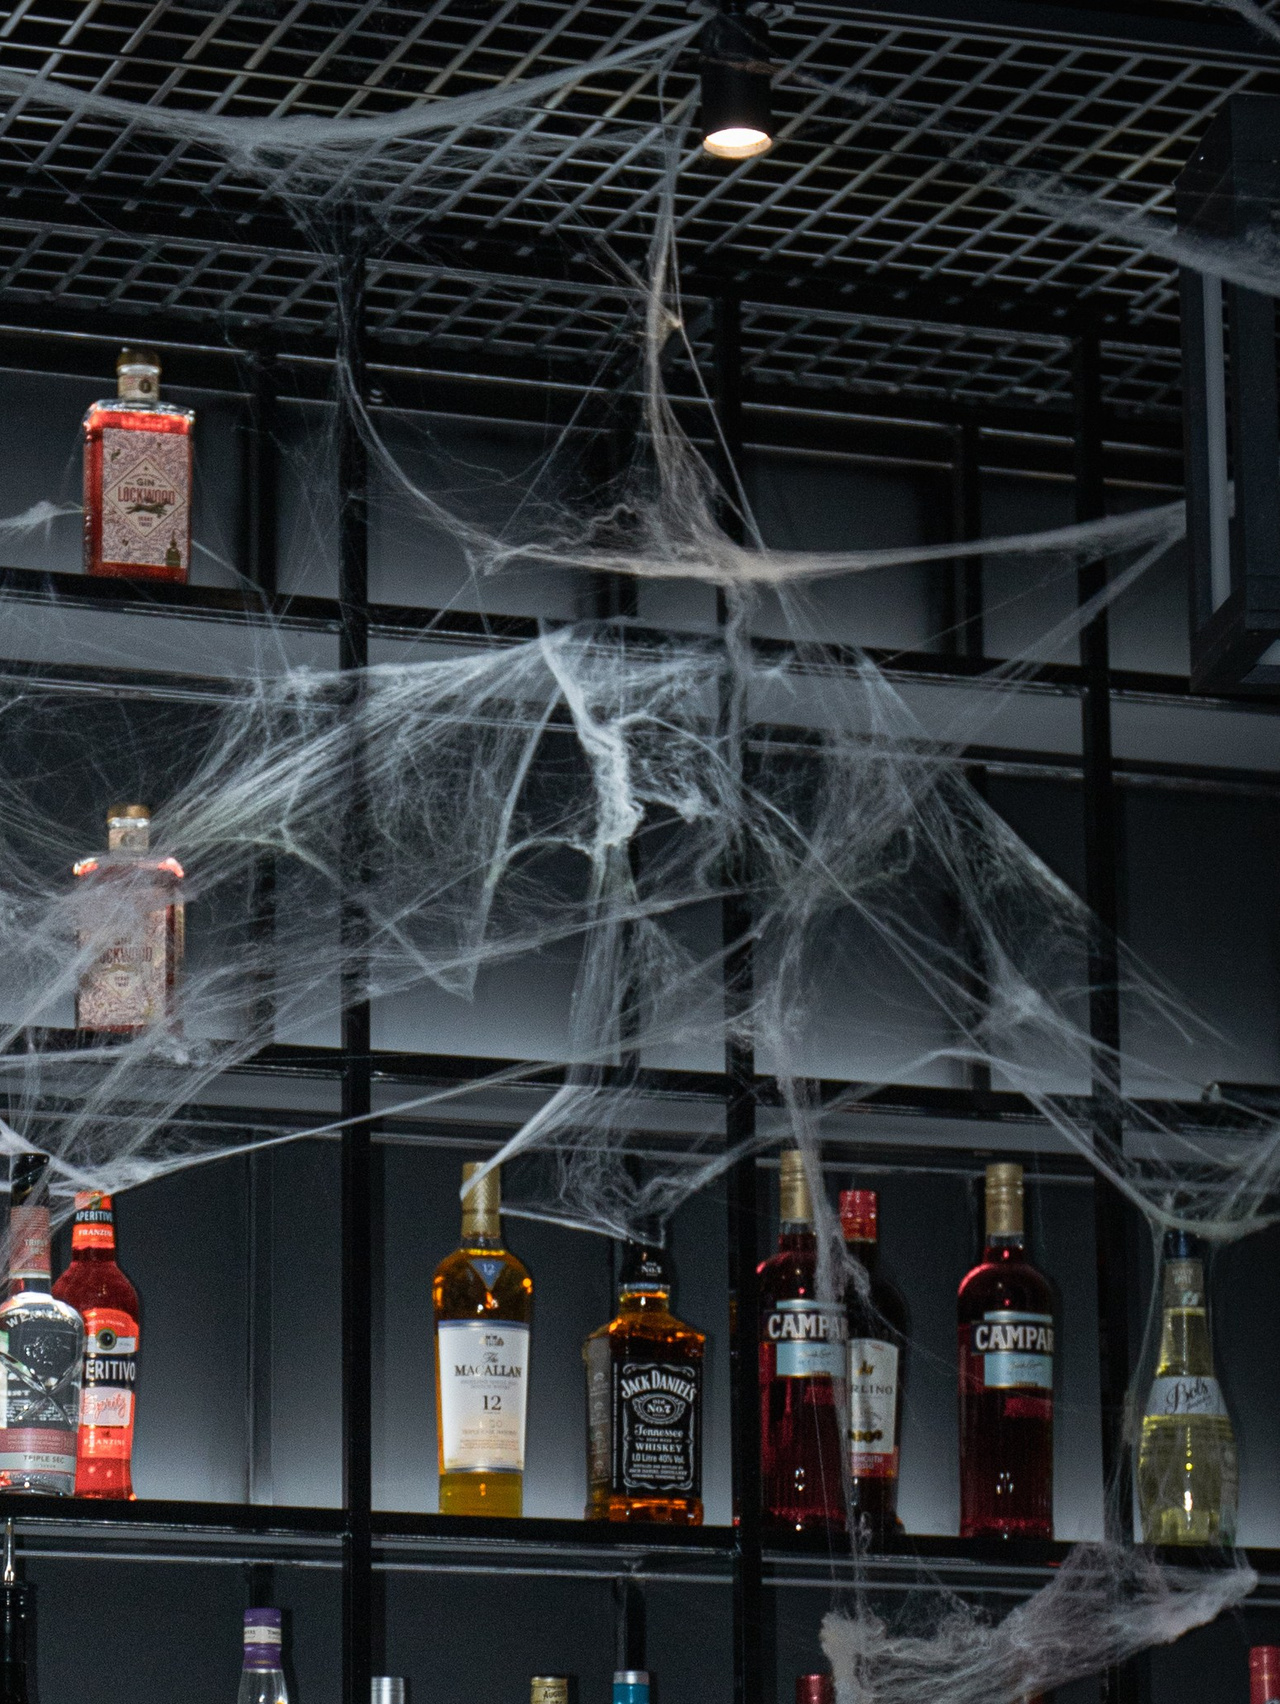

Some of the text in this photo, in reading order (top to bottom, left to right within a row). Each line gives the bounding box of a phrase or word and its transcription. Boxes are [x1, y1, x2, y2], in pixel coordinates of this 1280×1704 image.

[136, 478, 155, 486] GIN
[117, 486, 175, 505] LOCKWOOD
[975, 1325, 1055, 1351] CAMPAR
[85, 1359, 136, 1380] ERITIVO
[454, 1365, 522, 1378] MACALLAN
[621, 1369, 697, 1402] JACK DANIEL'S
[482, 1395, 502, 1411] 12
[647, 1404, 671, 1415] No.7
[634, 1423, 684, 1438] Tennessee
[635, 1443, 683, 1453] WHISKEY
[23, 1454, 65, 1464] TRIPLE SEC
